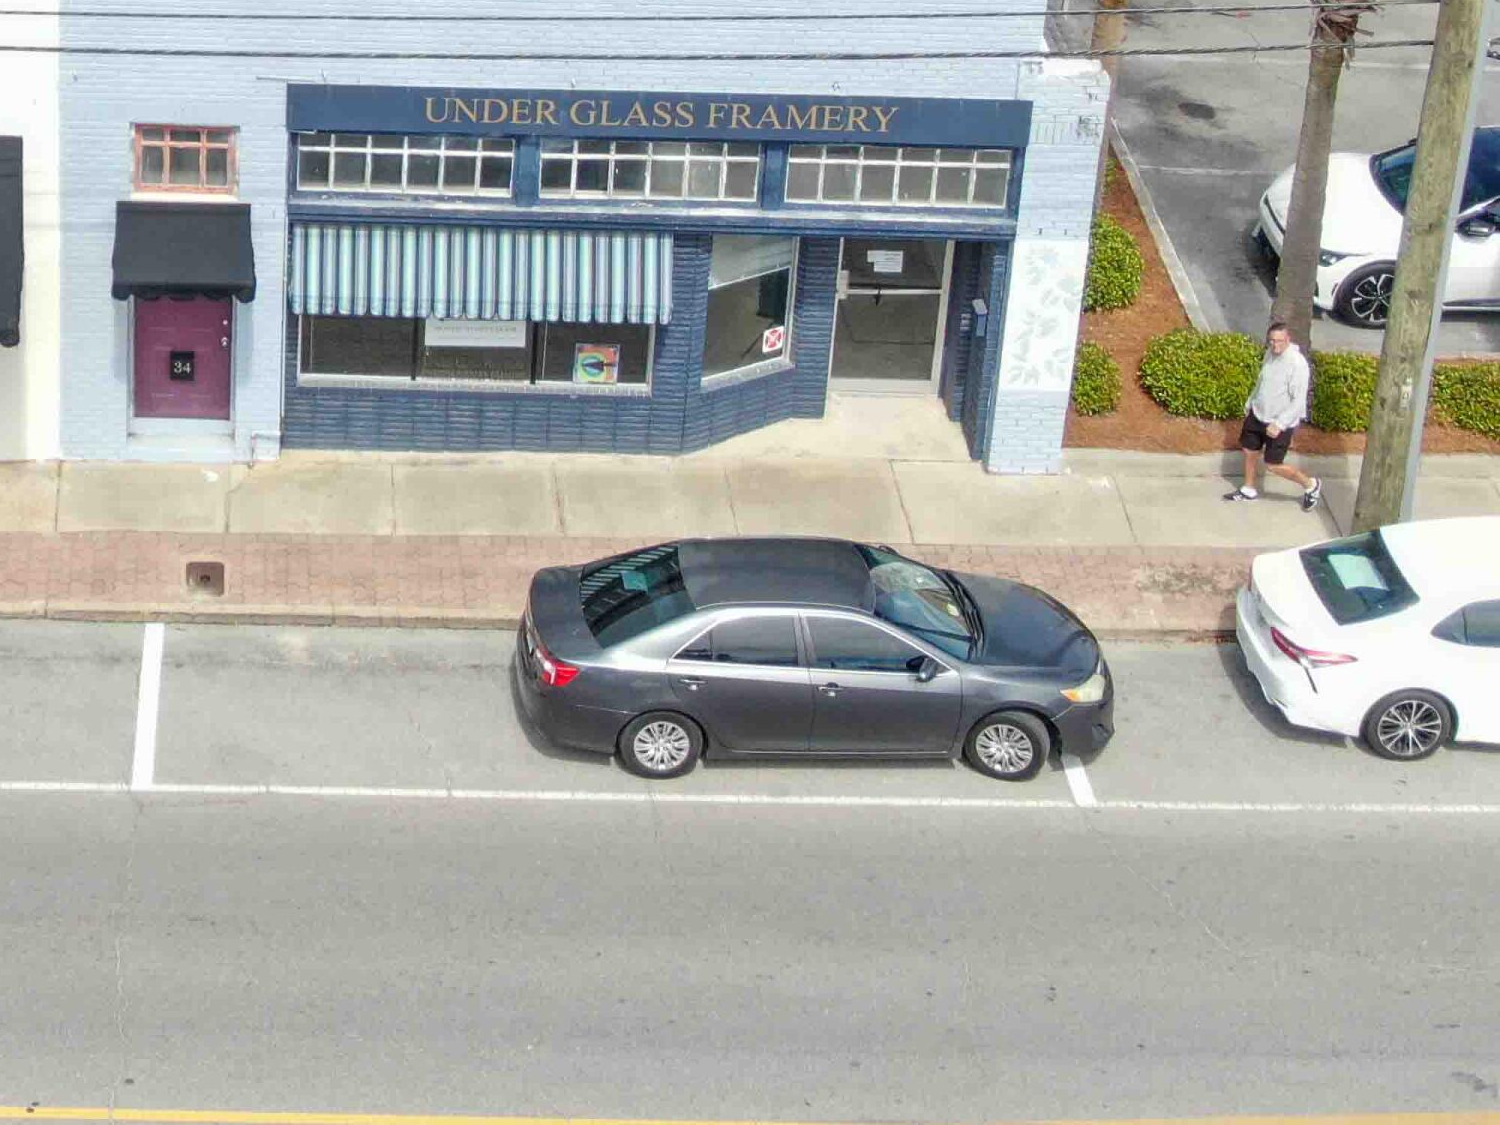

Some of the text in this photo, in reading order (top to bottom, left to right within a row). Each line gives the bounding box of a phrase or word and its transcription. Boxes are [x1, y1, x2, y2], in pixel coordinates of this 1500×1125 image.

[425, 97, 899, 133] UNDER GLASS FRAMERY
[173, 362, 191, 374] 34
